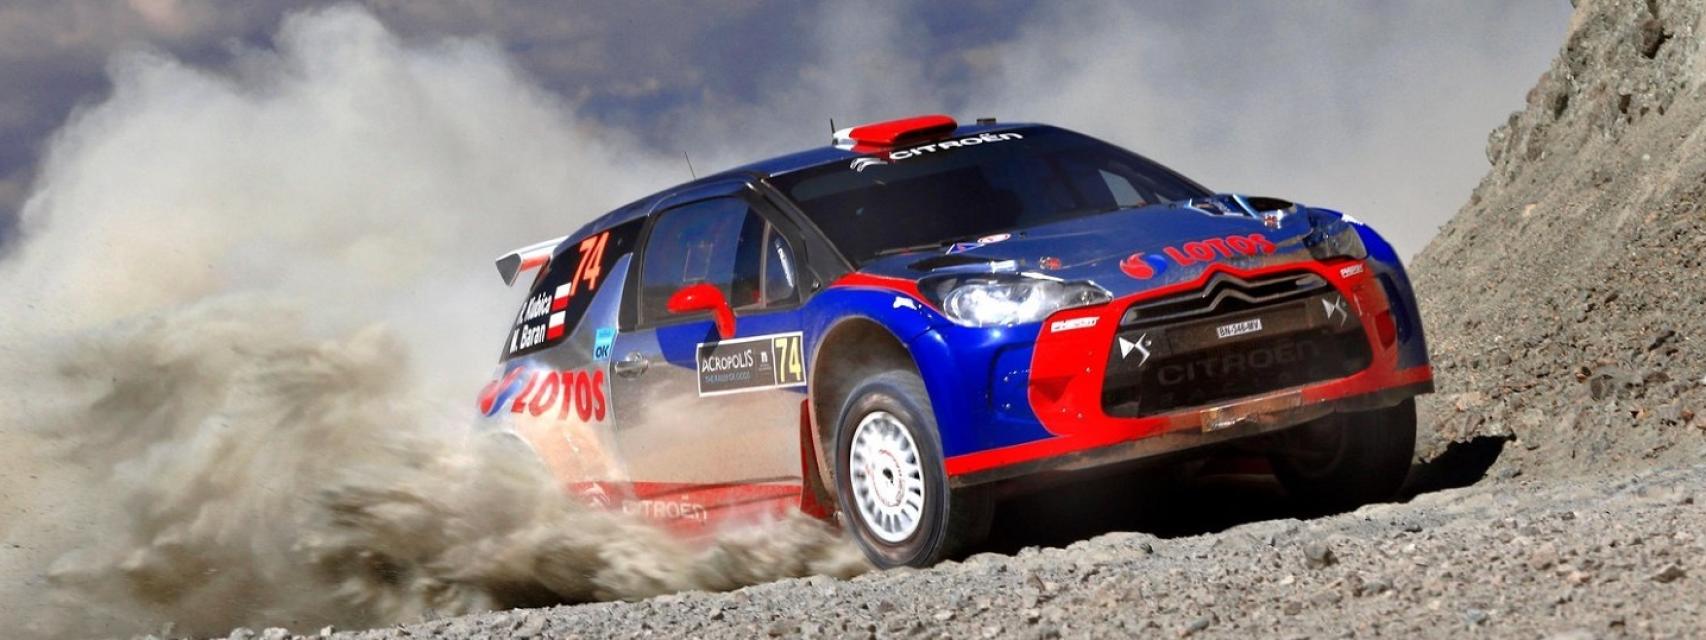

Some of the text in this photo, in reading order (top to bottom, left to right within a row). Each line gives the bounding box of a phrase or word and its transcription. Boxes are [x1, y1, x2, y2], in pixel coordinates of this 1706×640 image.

[889, 132, 1024, 160] CITROËN
[571, 231, 611, 296] 74
[1163, 234, 1277, 266] LOTOS
[524, 292, 552, 322] Kubica
[520, 324, 546, 349] Baran
[595, 344, 610, 359] OK
[701, 348, 754, 374] ACROPOLIS
[775, 336, 802, 383] 74
[511, 367, 608, 422] LOTOS
